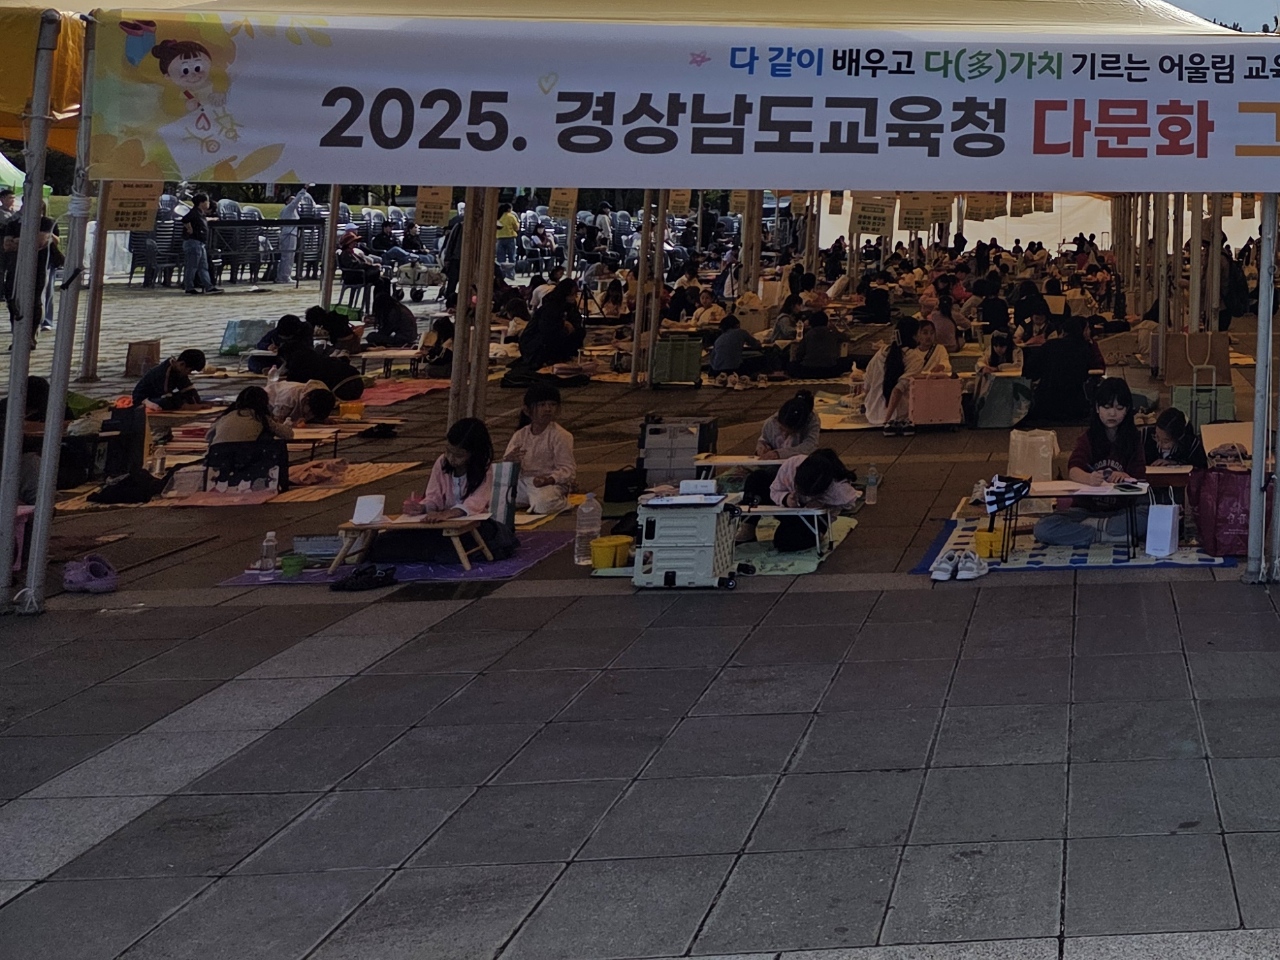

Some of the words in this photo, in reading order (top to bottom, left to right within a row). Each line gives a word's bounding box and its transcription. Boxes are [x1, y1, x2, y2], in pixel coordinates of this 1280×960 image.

[730, 47, 760, 75] 다
[768, 47, 824, 77] 같이
[831, 48, 916, 78] 배우고
[924, 49, 1063, 83] 다(多)가치
[1071, 52, 1151, 83] 기르는
[1158, 52, 1235, 84] 어울림
[319, 86, 528, 152] 2025.
[554, 90, 1007, 158] 경상남도교육청
[1032, 98, 1215, 159] 다문화
